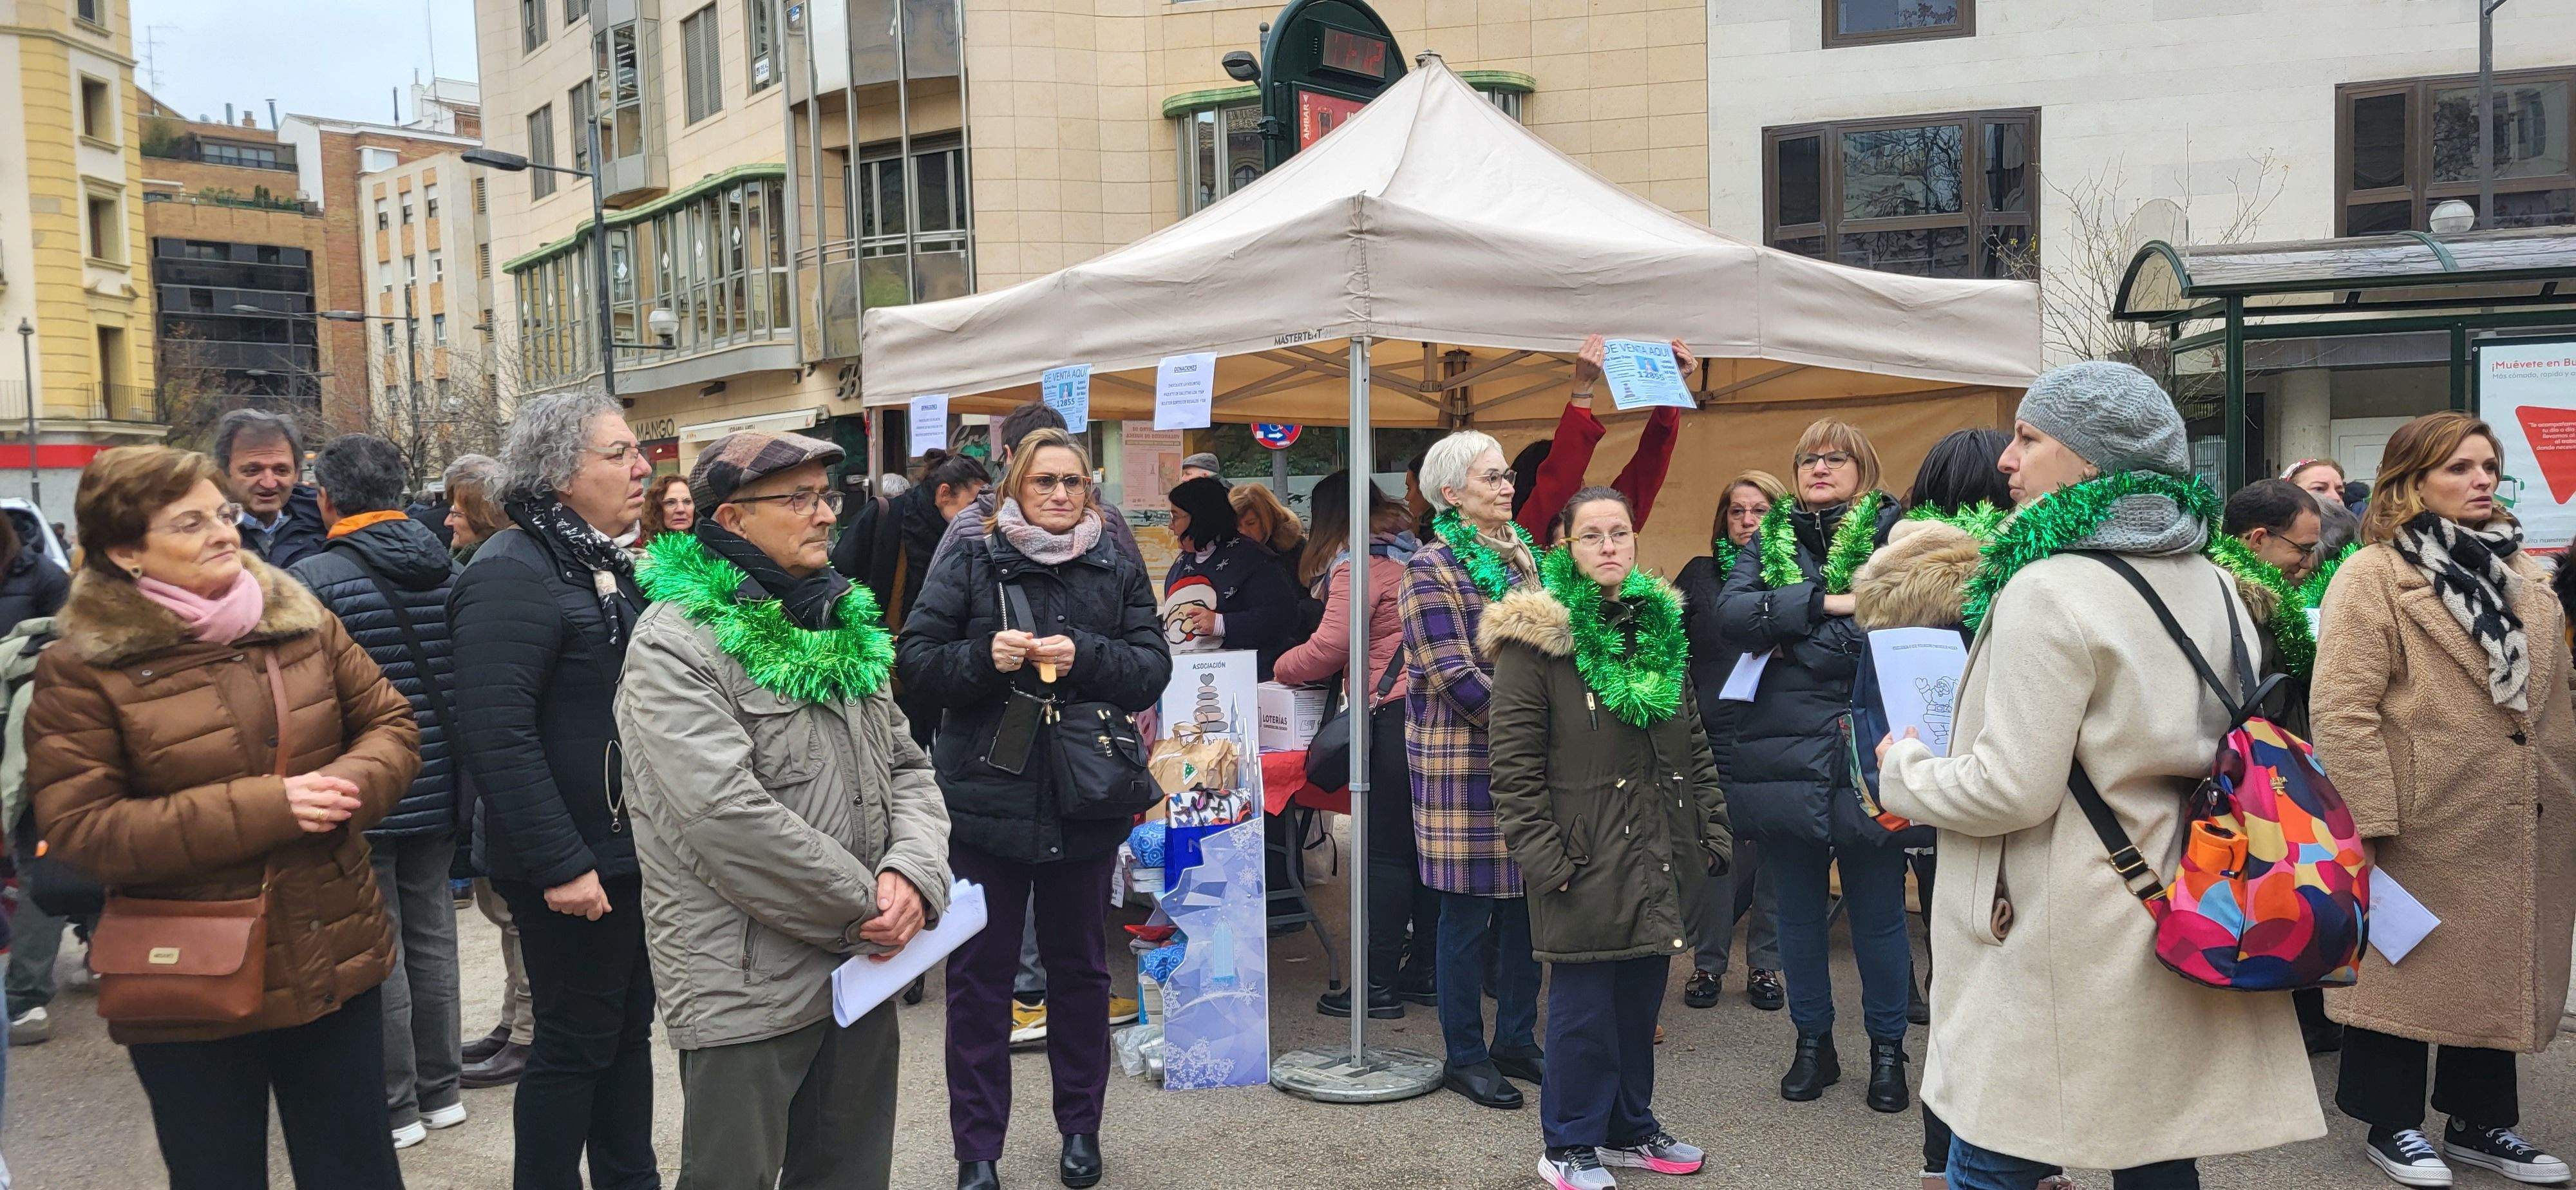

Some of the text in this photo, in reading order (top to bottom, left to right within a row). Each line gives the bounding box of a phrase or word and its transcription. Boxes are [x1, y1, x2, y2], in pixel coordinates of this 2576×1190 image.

[1303, 104, 1311, 140] AMBAR
[1604, 344, 1618, 354] DE
[1619, 343, 1647, 354] VENTA
[2492, 360, 2543, 372] ¡Muévete
[1044, 373, 1052, 383] DE
[1053, 371, 1071, 382] VENTA
[1637, 371, 1665, 381] 12855
[1057, 398, 1075, 408] 12855
[636, 418, 675, 440] MANGO
[1192, 661, 1226, 670] ASOCIACIÓN
[1263, 714, 1287, 725] LOTERÍAS
